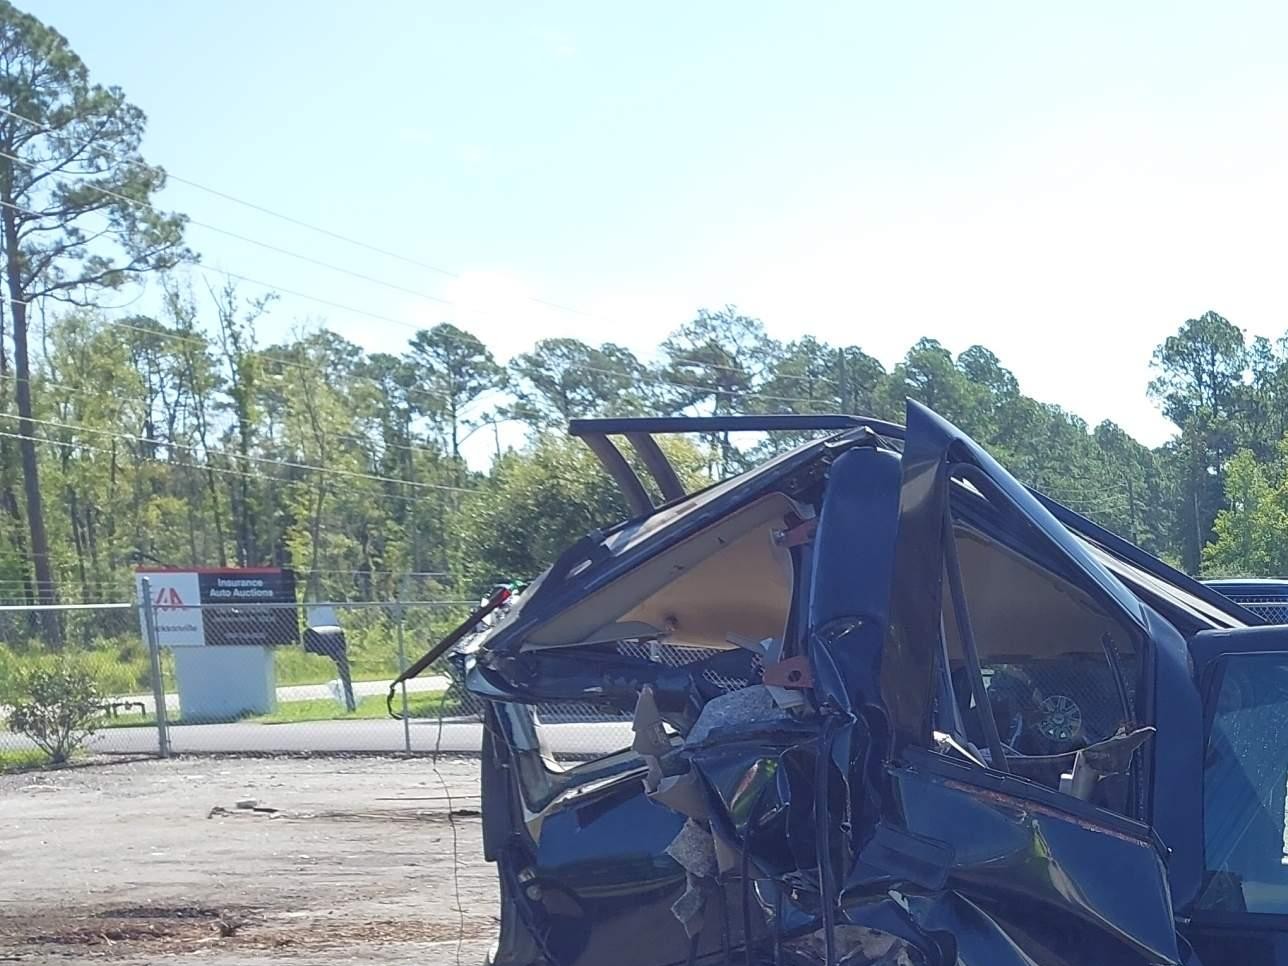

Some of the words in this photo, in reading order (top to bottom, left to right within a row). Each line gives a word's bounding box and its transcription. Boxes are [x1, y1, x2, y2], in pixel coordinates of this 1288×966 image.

[217, 578, 263, 587] Insurance
[209, 588, 231, 597] Auto
[233, 588, 273, 597] Auctions
